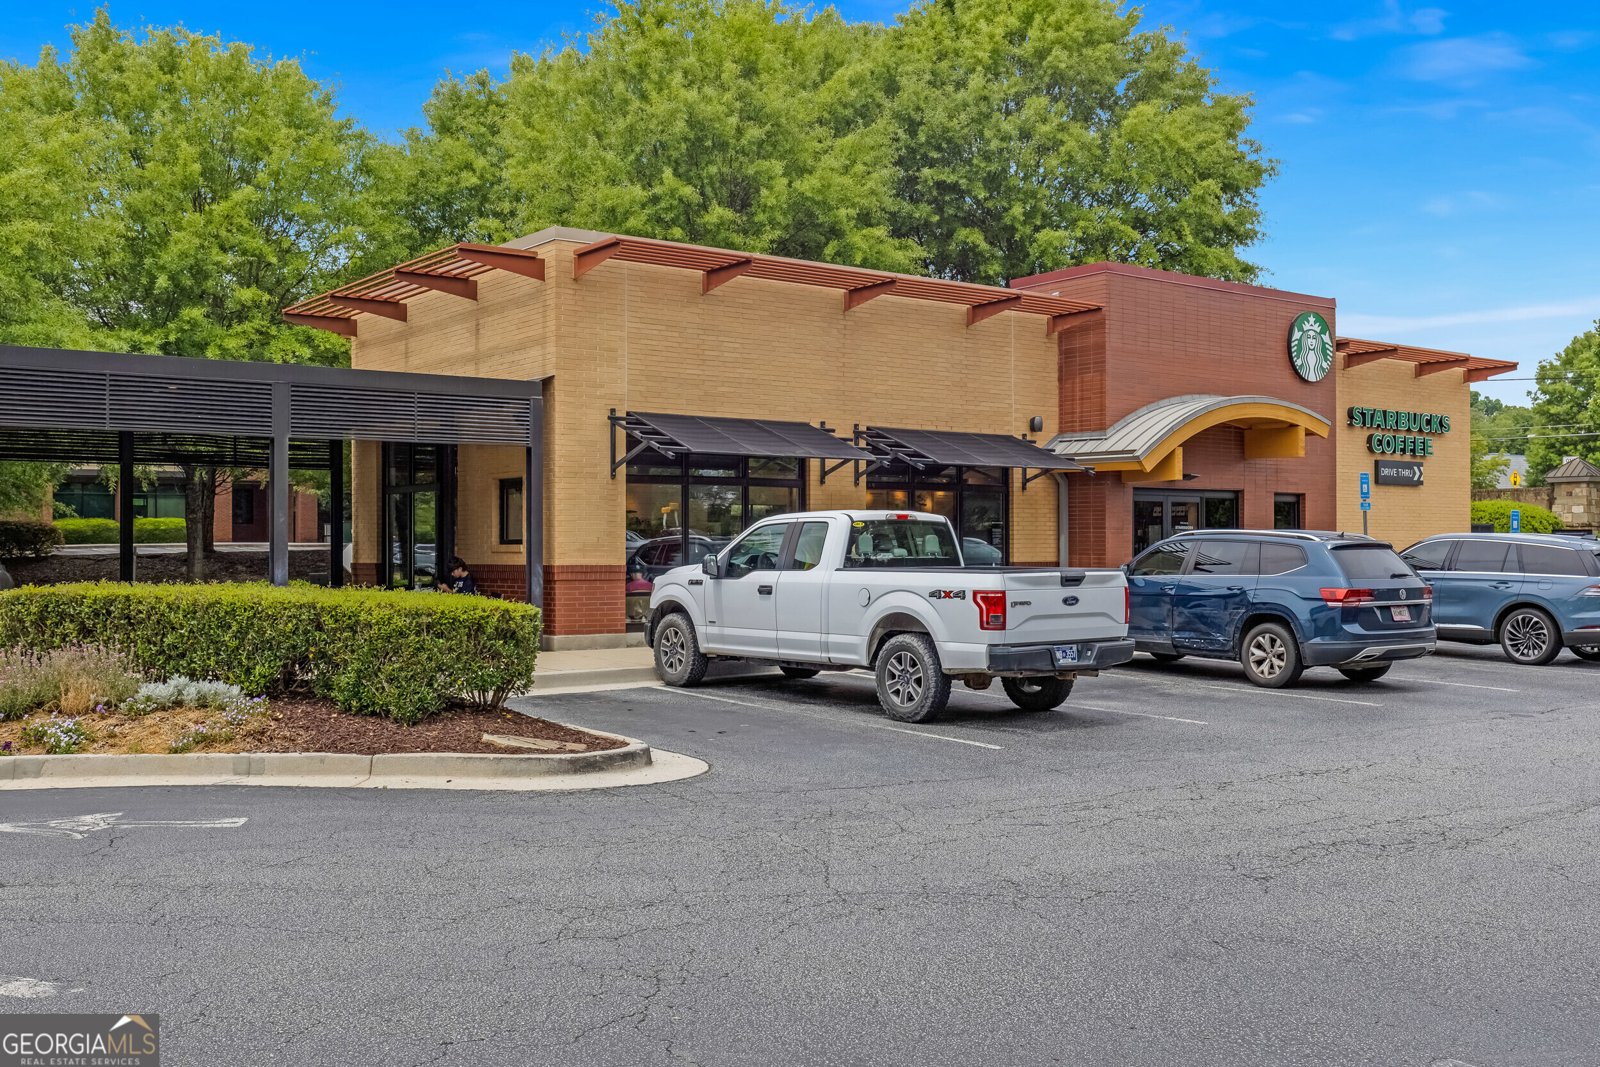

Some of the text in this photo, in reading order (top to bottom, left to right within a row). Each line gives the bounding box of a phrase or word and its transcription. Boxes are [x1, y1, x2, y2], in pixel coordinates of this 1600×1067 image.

[1351, 406, 1451, 434] STARBUCKS
[1371, 432, 1434, 456] COFFEE
[1380, 467, 1413, 478] DRIVE THRU
